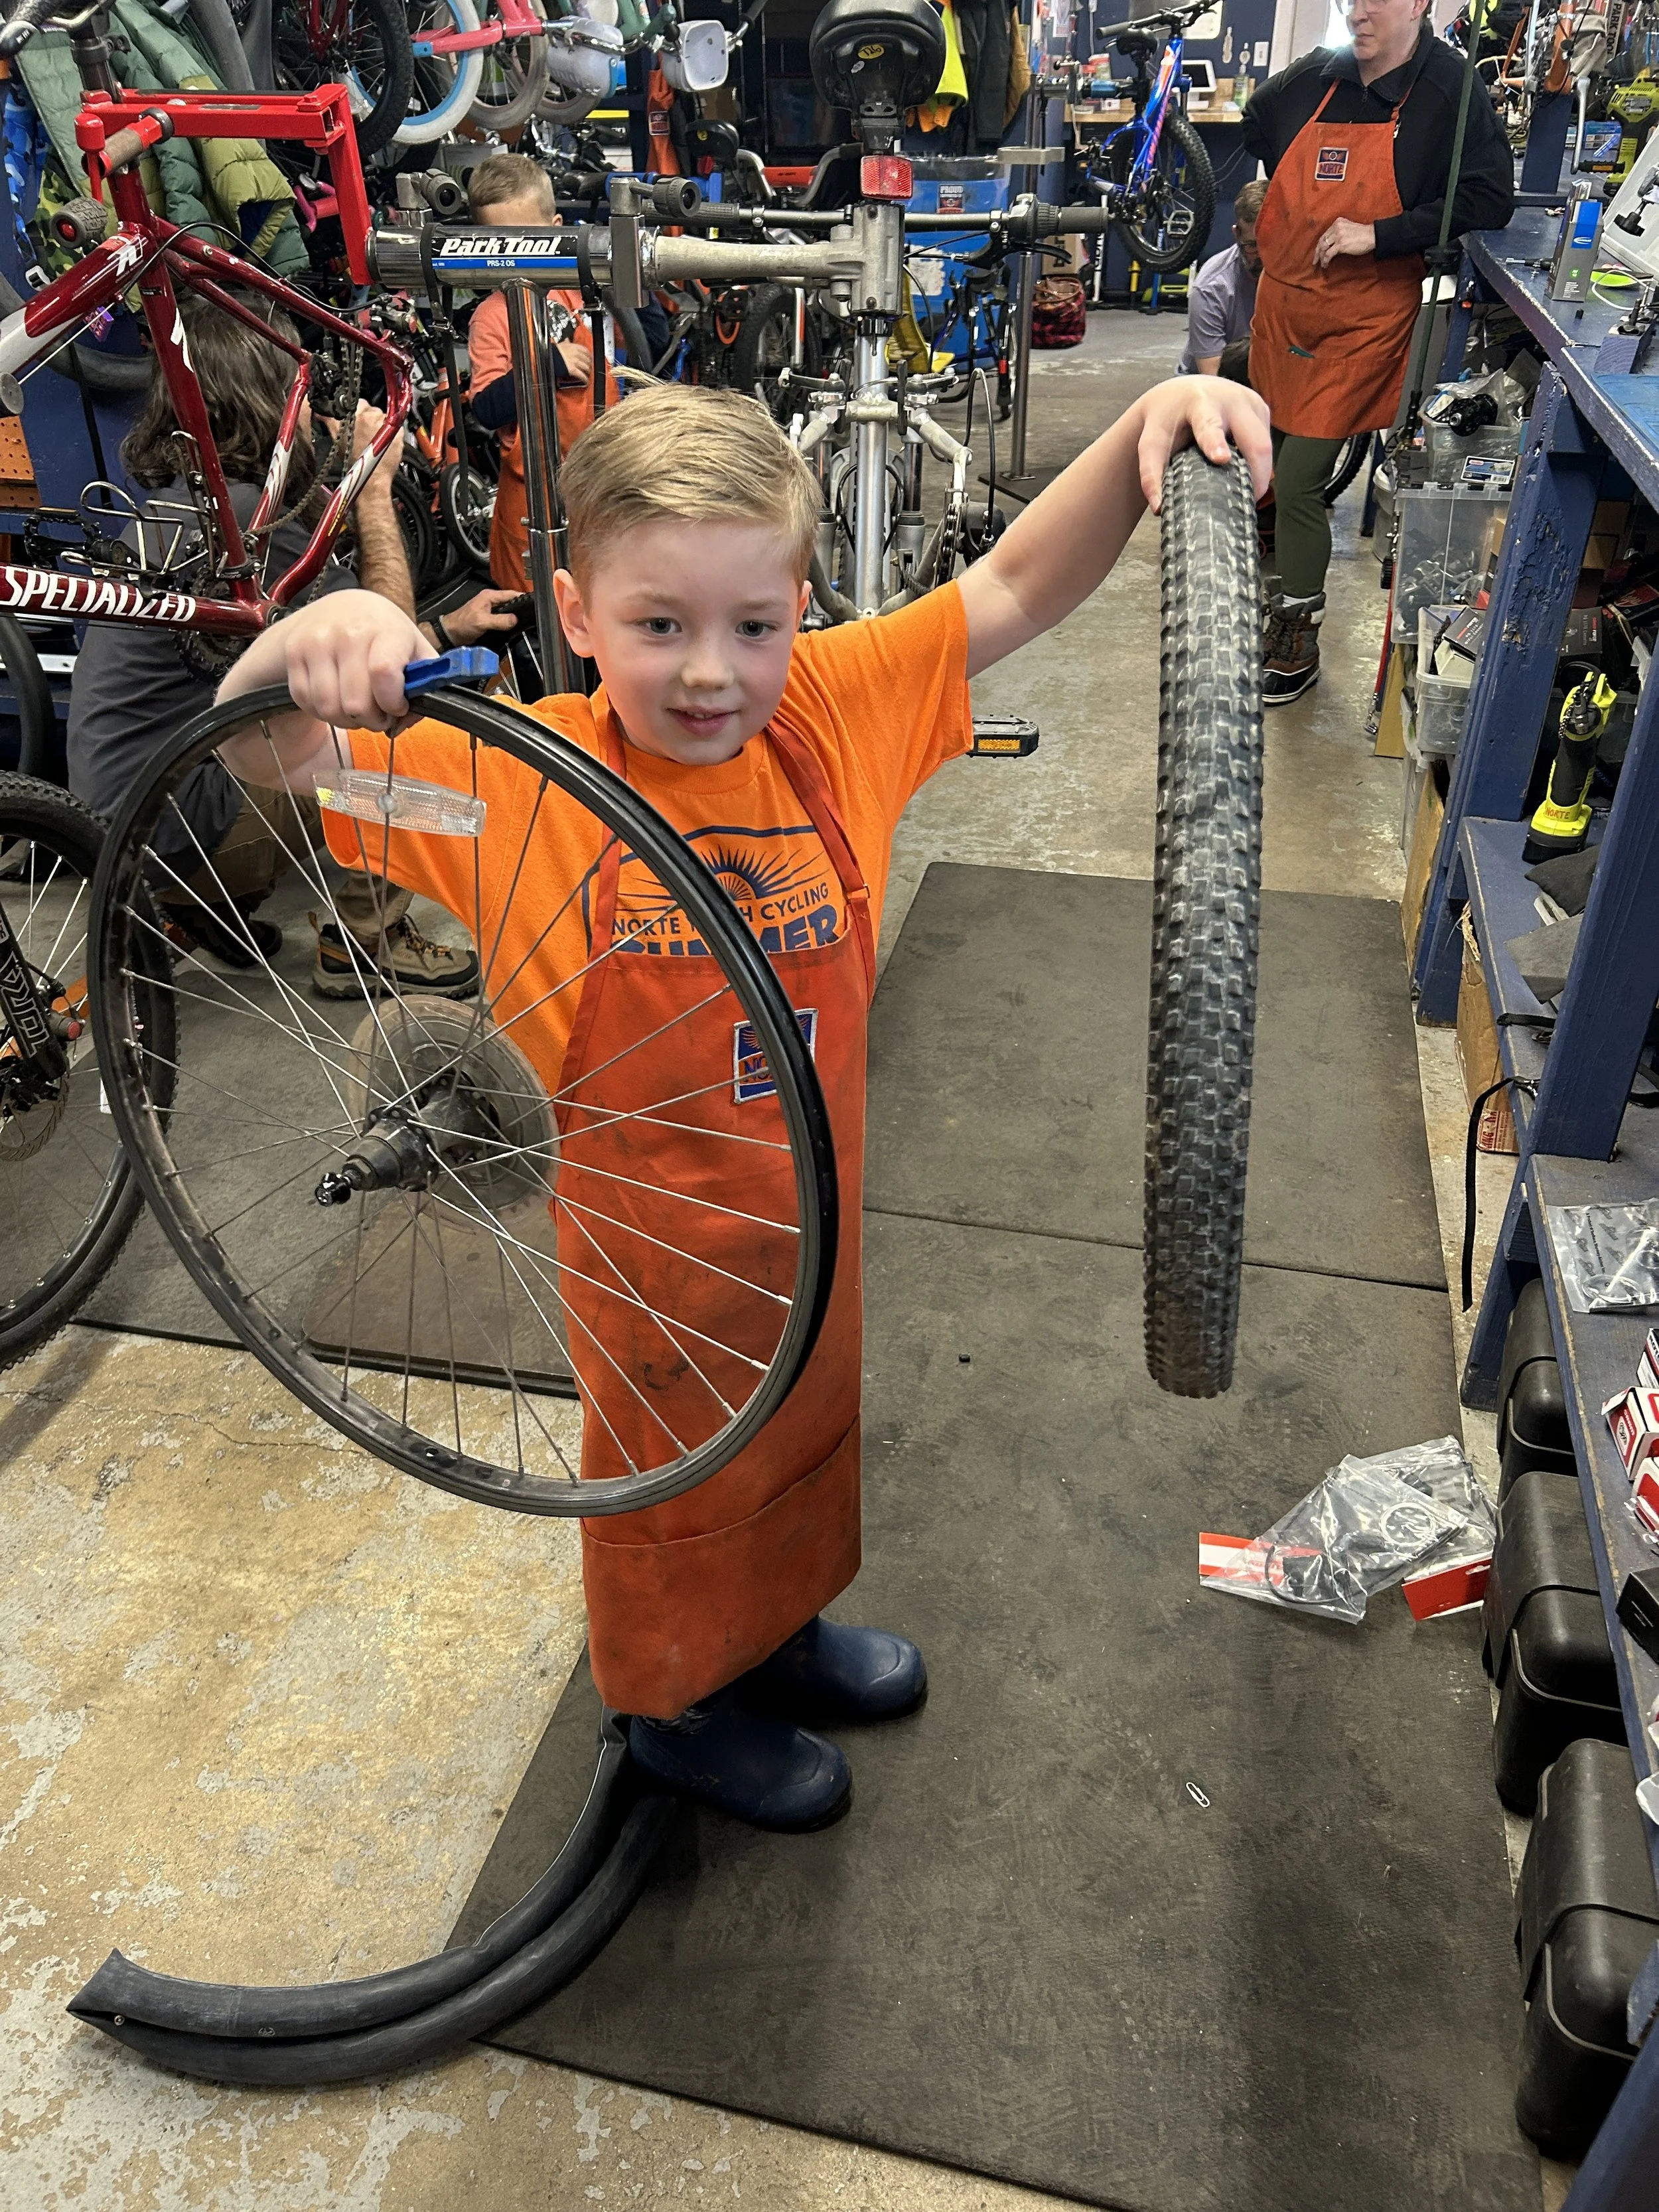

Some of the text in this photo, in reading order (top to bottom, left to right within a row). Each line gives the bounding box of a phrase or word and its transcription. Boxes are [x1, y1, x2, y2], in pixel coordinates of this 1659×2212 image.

[1609, 3, 1622, 29] PARK
[1545, 807, 1571, 820] NORTE
[613, 917, 681, 936] NORTE
[760, 881, 829, 921] CYCLING
[0, 950, 50, 1059] TORA
